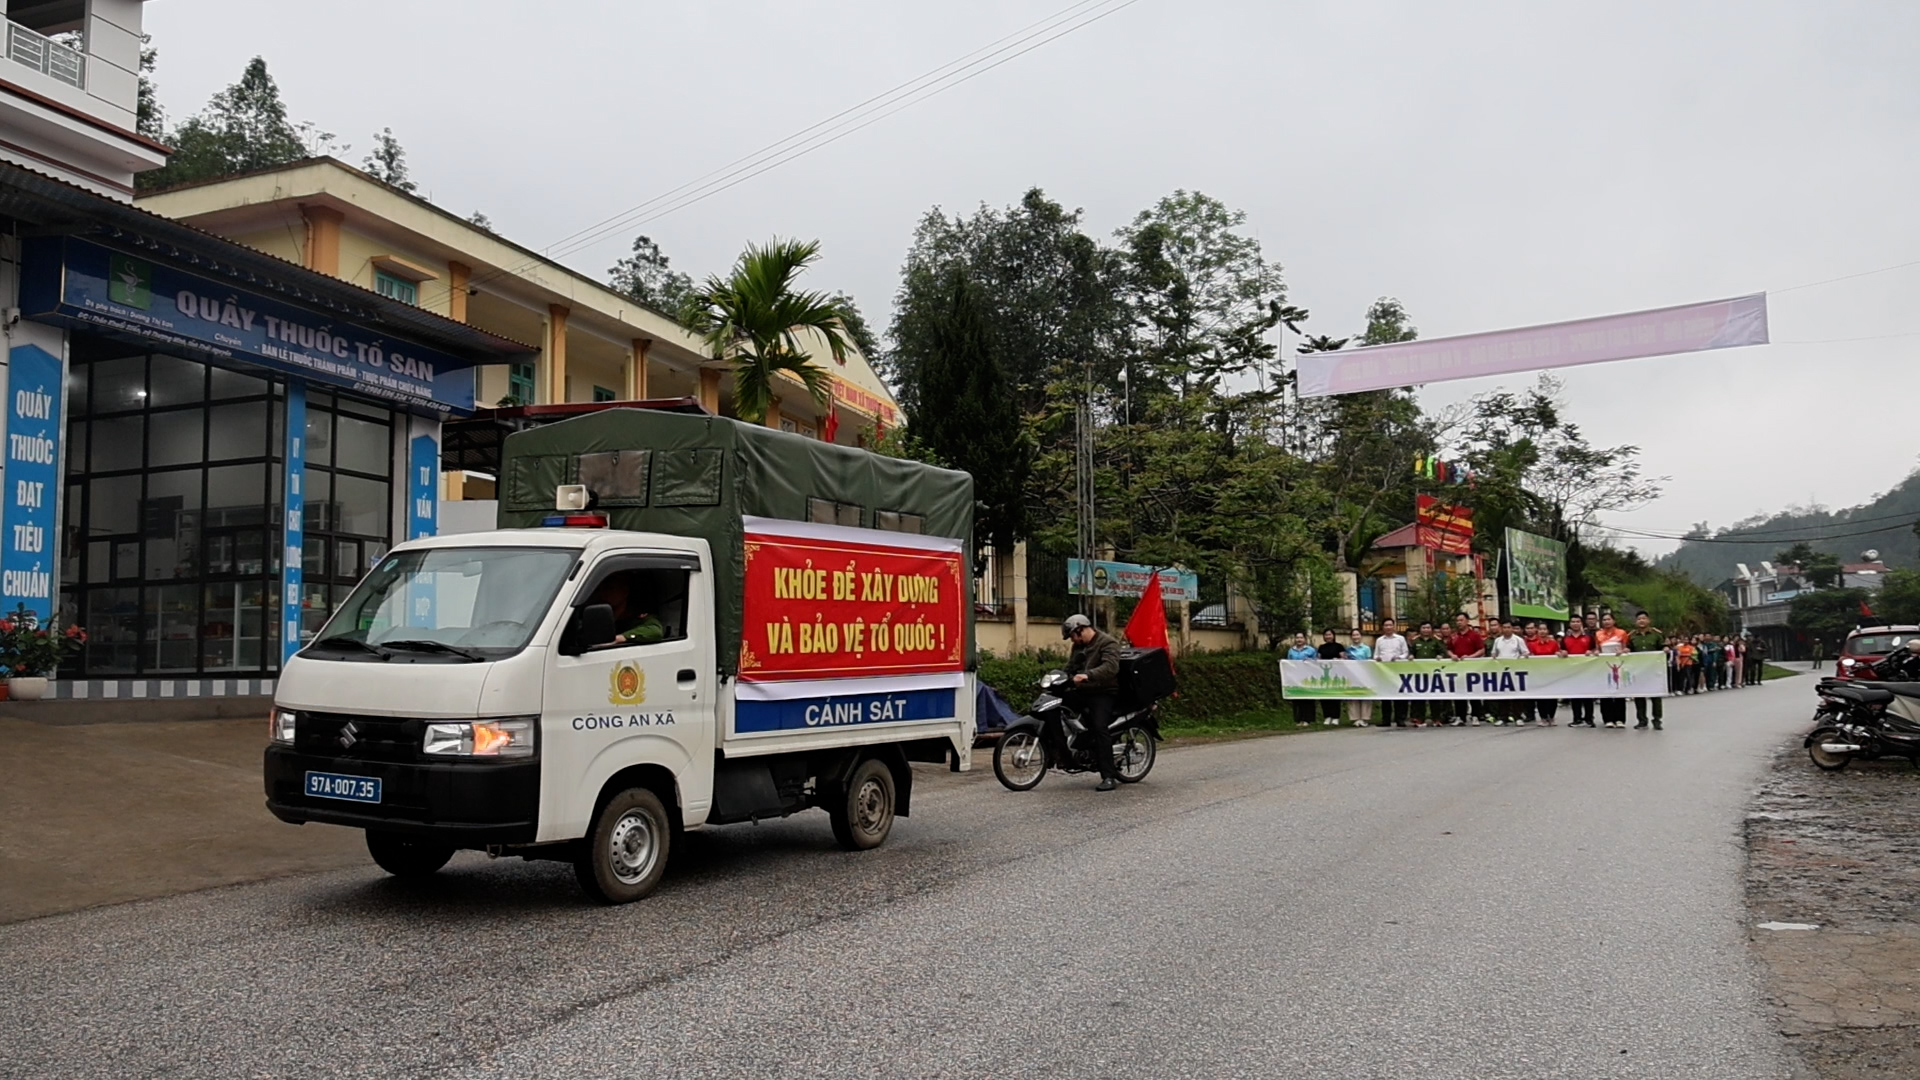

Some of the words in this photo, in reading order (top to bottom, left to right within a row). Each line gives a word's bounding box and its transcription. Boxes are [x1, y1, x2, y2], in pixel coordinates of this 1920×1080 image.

[264, 315, 349, 358] THUỐC
[355, 339, 384, 368] TỐ
[390, 352, 433, 382] SAN
[10, 430, 54, 464] THUỐC
[17, 480, 44, 512] ĐẠT
[14, 520, 43, 553] TIÊU
[3, 561, 49, 599] CHUẨN
[774, 559, 827, 600] KHỎE
[833, 560, 856, 601] ĐỂ
[861, 567, 894, 603] XÂY
[898, 573, 939, 609] DỰNG
[767, 616, 794, 654] VÀ
[800, 612, 838, 654] BẢO
[843, 617, 864, 658] VỆ
[870, 612, 890, 652] TỔ
[894, 613, 935, 655] QUỐC
[939, 624, 945, 651] !
[1398, 666, 1458, 694] XUẤT
[1466, 667, 1528, 693] PHÁT
[572, 713, 623, 731] CÔNG
[629, 714, 650, 727] AN
[655, 709, 675, 725] XÃ
[869, 694, 907, 721] SÁT
